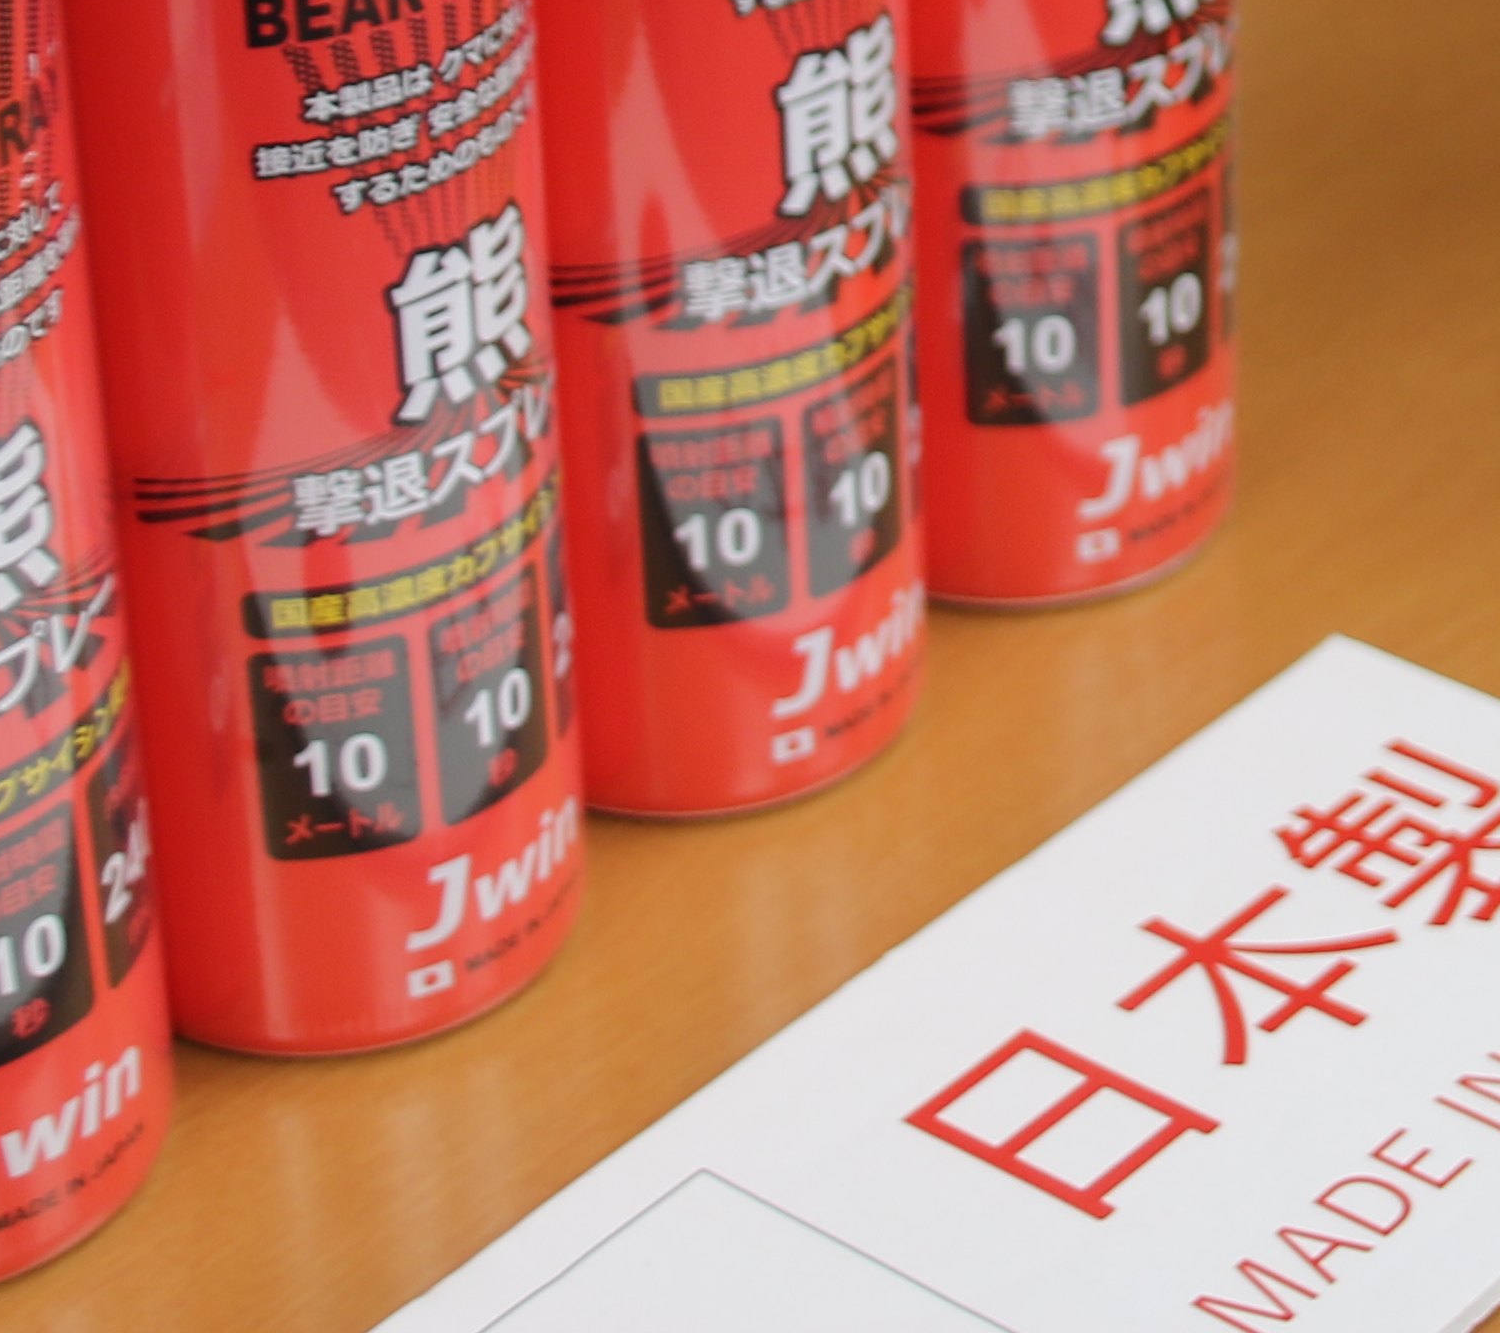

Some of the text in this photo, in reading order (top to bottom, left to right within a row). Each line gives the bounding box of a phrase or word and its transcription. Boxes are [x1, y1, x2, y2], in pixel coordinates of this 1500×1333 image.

[303, 63, 433, 121] 本製品は
[777, 14, 898, 215] 熊
[255, 113, 421, 178] 接近を防ぎ
[391, 203, 531, 420] 熊
[1138, 272, 1203, 345] 10
[992, 314, 1076, 376] 10
[828, 451, 891, 529] 10
[674, 507, 762, 571] 10
[283, 689, 383, 725] の目安
[464, 667, 532, 747] 10
[293, 732, 388, 797] 10
[286, 801, 406, 844] メートル
[406, 795, 579, 953] Jwin
[1191, 1128, 1475, 1333] MADE
